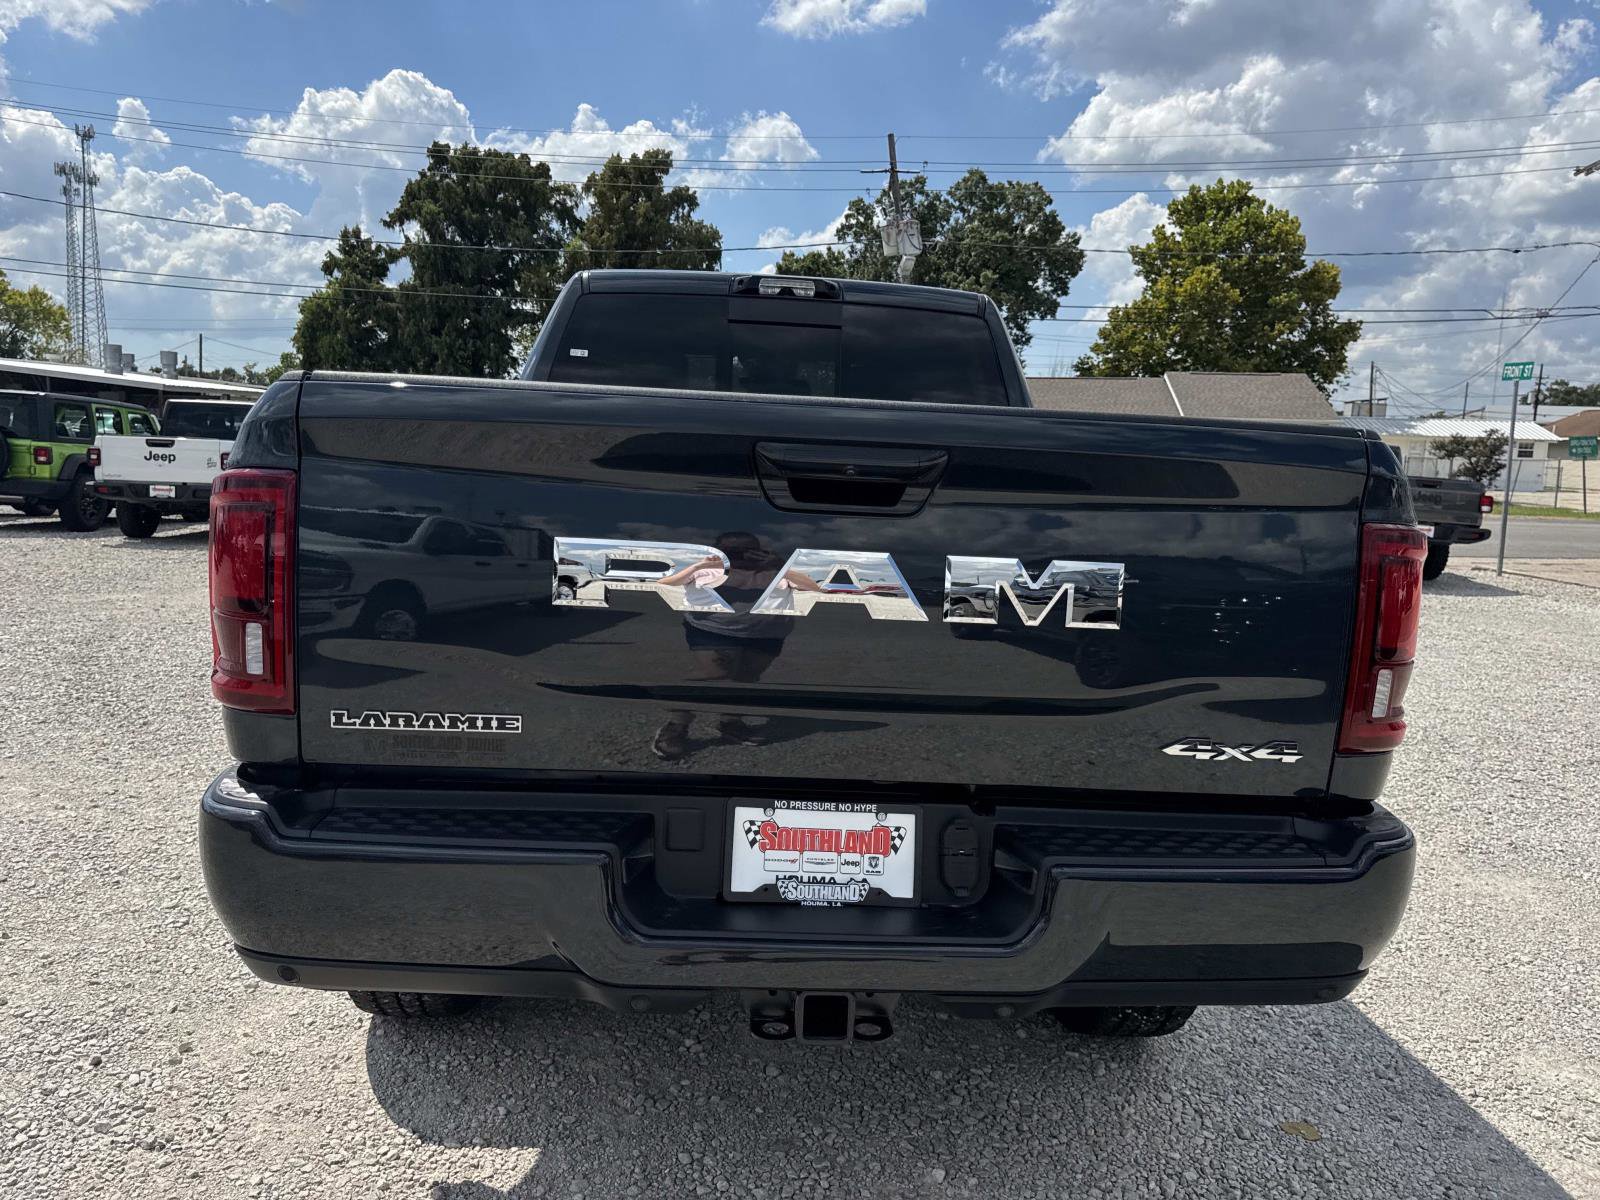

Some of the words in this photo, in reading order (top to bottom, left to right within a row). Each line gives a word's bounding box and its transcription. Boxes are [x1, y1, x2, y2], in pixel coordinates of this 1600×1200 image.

[1523, 364, 1533, 378] ST
[144, 450, 176, 464] Jeep
[552, 536, 1126, 630] RAM
[330, 709, 522, 734] LARAMIE
[774, 800, 788, 810] NO
[789, 800, 836, 812] PRESSURE
[838, 803, 852, 812] NO
[854, 803, 878, 813] HYPE
[758, 820, 892, 858] SOUTHLAND
[840, 858, 860, 868] Jeep
[787, 881, 860, 901] SOUTHLAND
